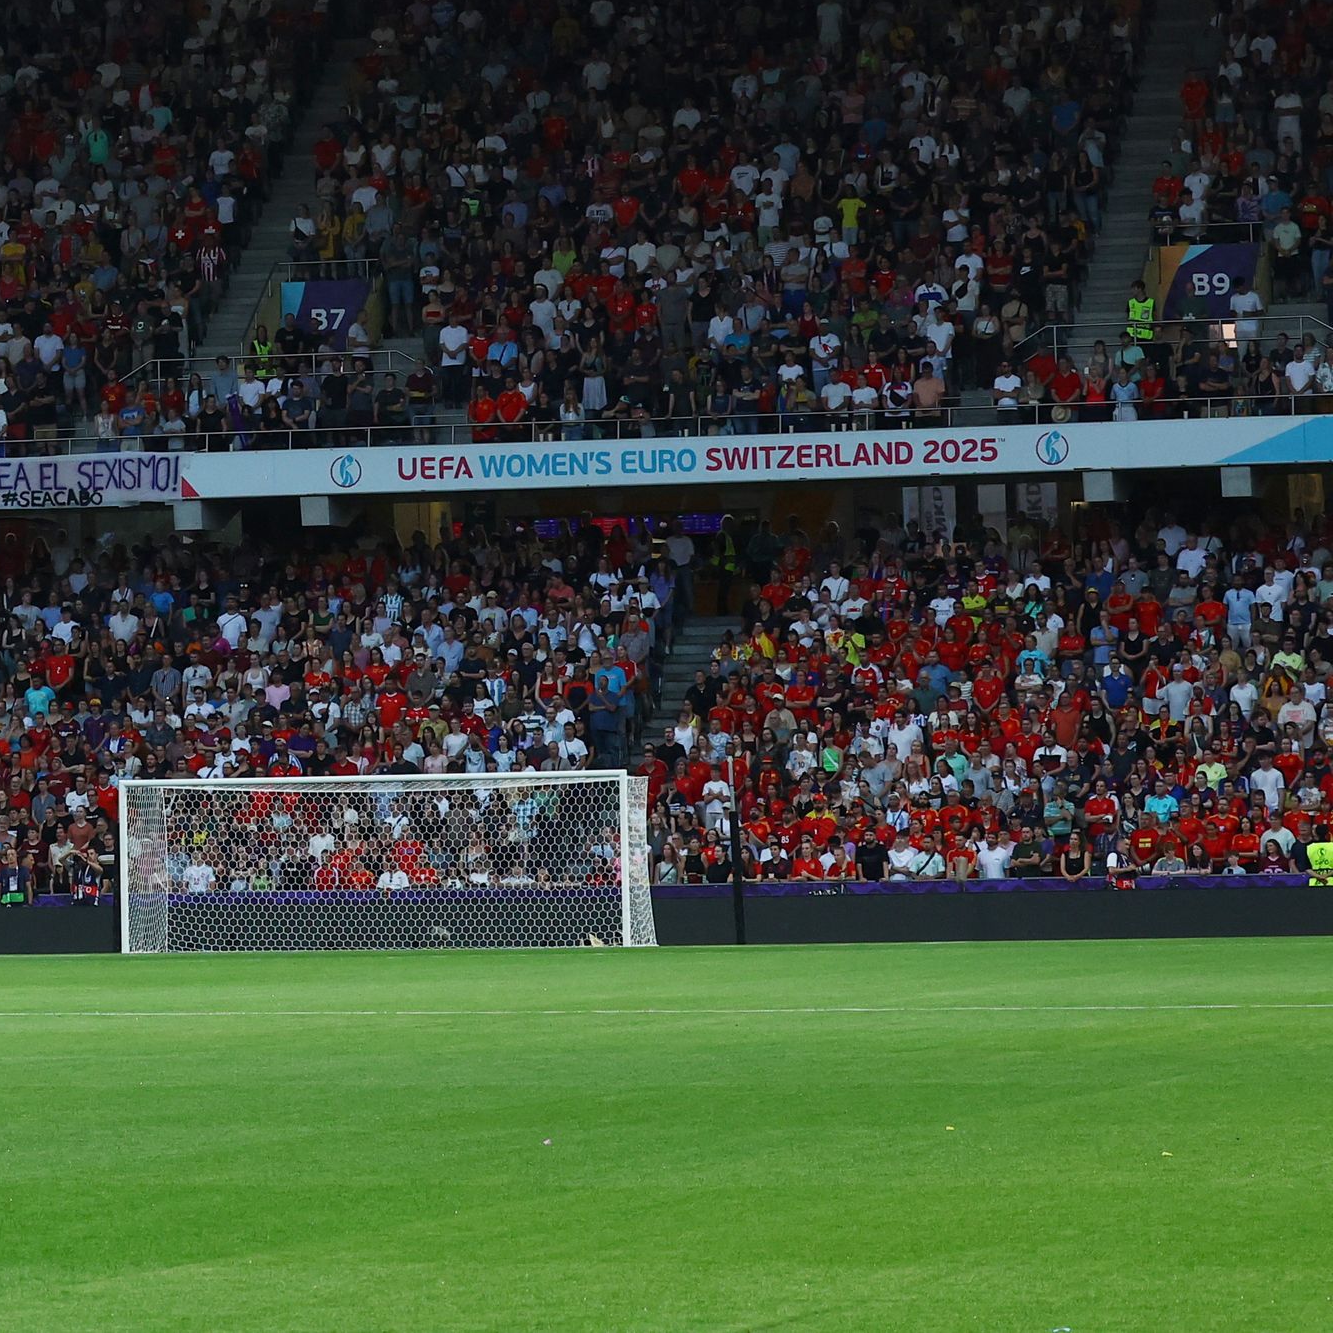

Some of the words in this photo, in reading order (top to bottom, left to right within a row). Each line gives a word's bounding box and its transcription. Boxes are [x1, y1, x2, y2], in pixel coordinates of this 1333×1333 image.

[1191, 272, 1231, 296] B9
[39, 463, 67, 491] EL
[76, 455, 180, 492] SEXISMO!
[397, 456, 474, 481] UEFA
[478, 451, 612, 478] WOMEN'S
[619, 448, 696, 474] EURO
[705, 440, 913, 471] SWITZERLAND
